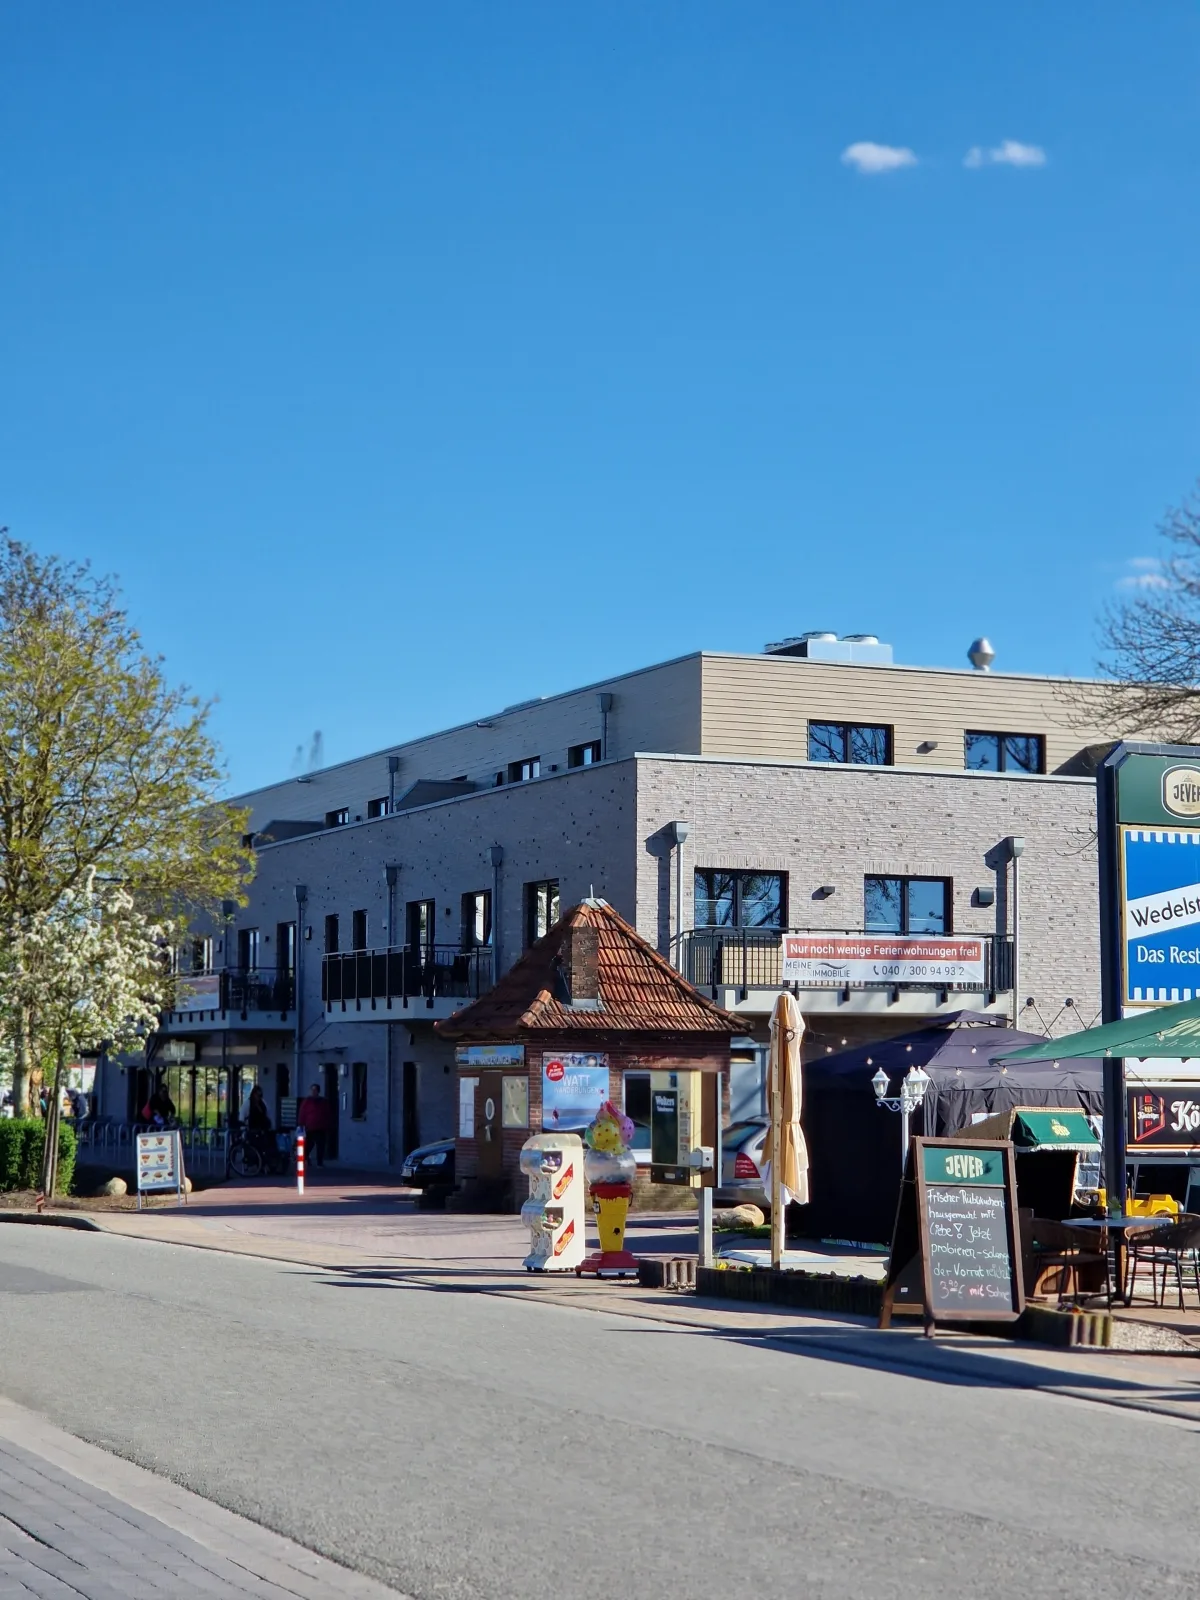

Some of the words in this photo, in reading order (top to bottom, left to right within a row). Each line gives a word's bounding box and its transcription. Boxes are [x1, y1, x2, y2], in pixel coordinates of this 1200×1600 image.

[790, 943, 808, 954] Nur
[810, 944, 834, 955] noch
[837, 944, 872, 957] wenige
[873, 945, 957, 958] Ferienwohnungen
[959, 945, 978, 957] frei!
[1137, 945, 1165, 963] Das
[785, 961, 812, 970] MEINE
[881, 965, 900, 975] 040
[909, 966, 927, 976] 300
[930, 966, 942, 976] 94
[944, 966, 956, 976] 93
[958, 966, 965, 976] 2
[562, 1074, 591, 1087] WATT
[945, 1154, 984, 1179] JEVER
[927, 1189, 960, 1204] Frischer
[928, 1206, 978, 1222] hausgemacht
[980, 1209, 997, 1219] mit
[933, 1262, 952, 1277] der
[953, 1263, 984, 1278] Vorrat
[969, 1285, 985, 1297] mit
